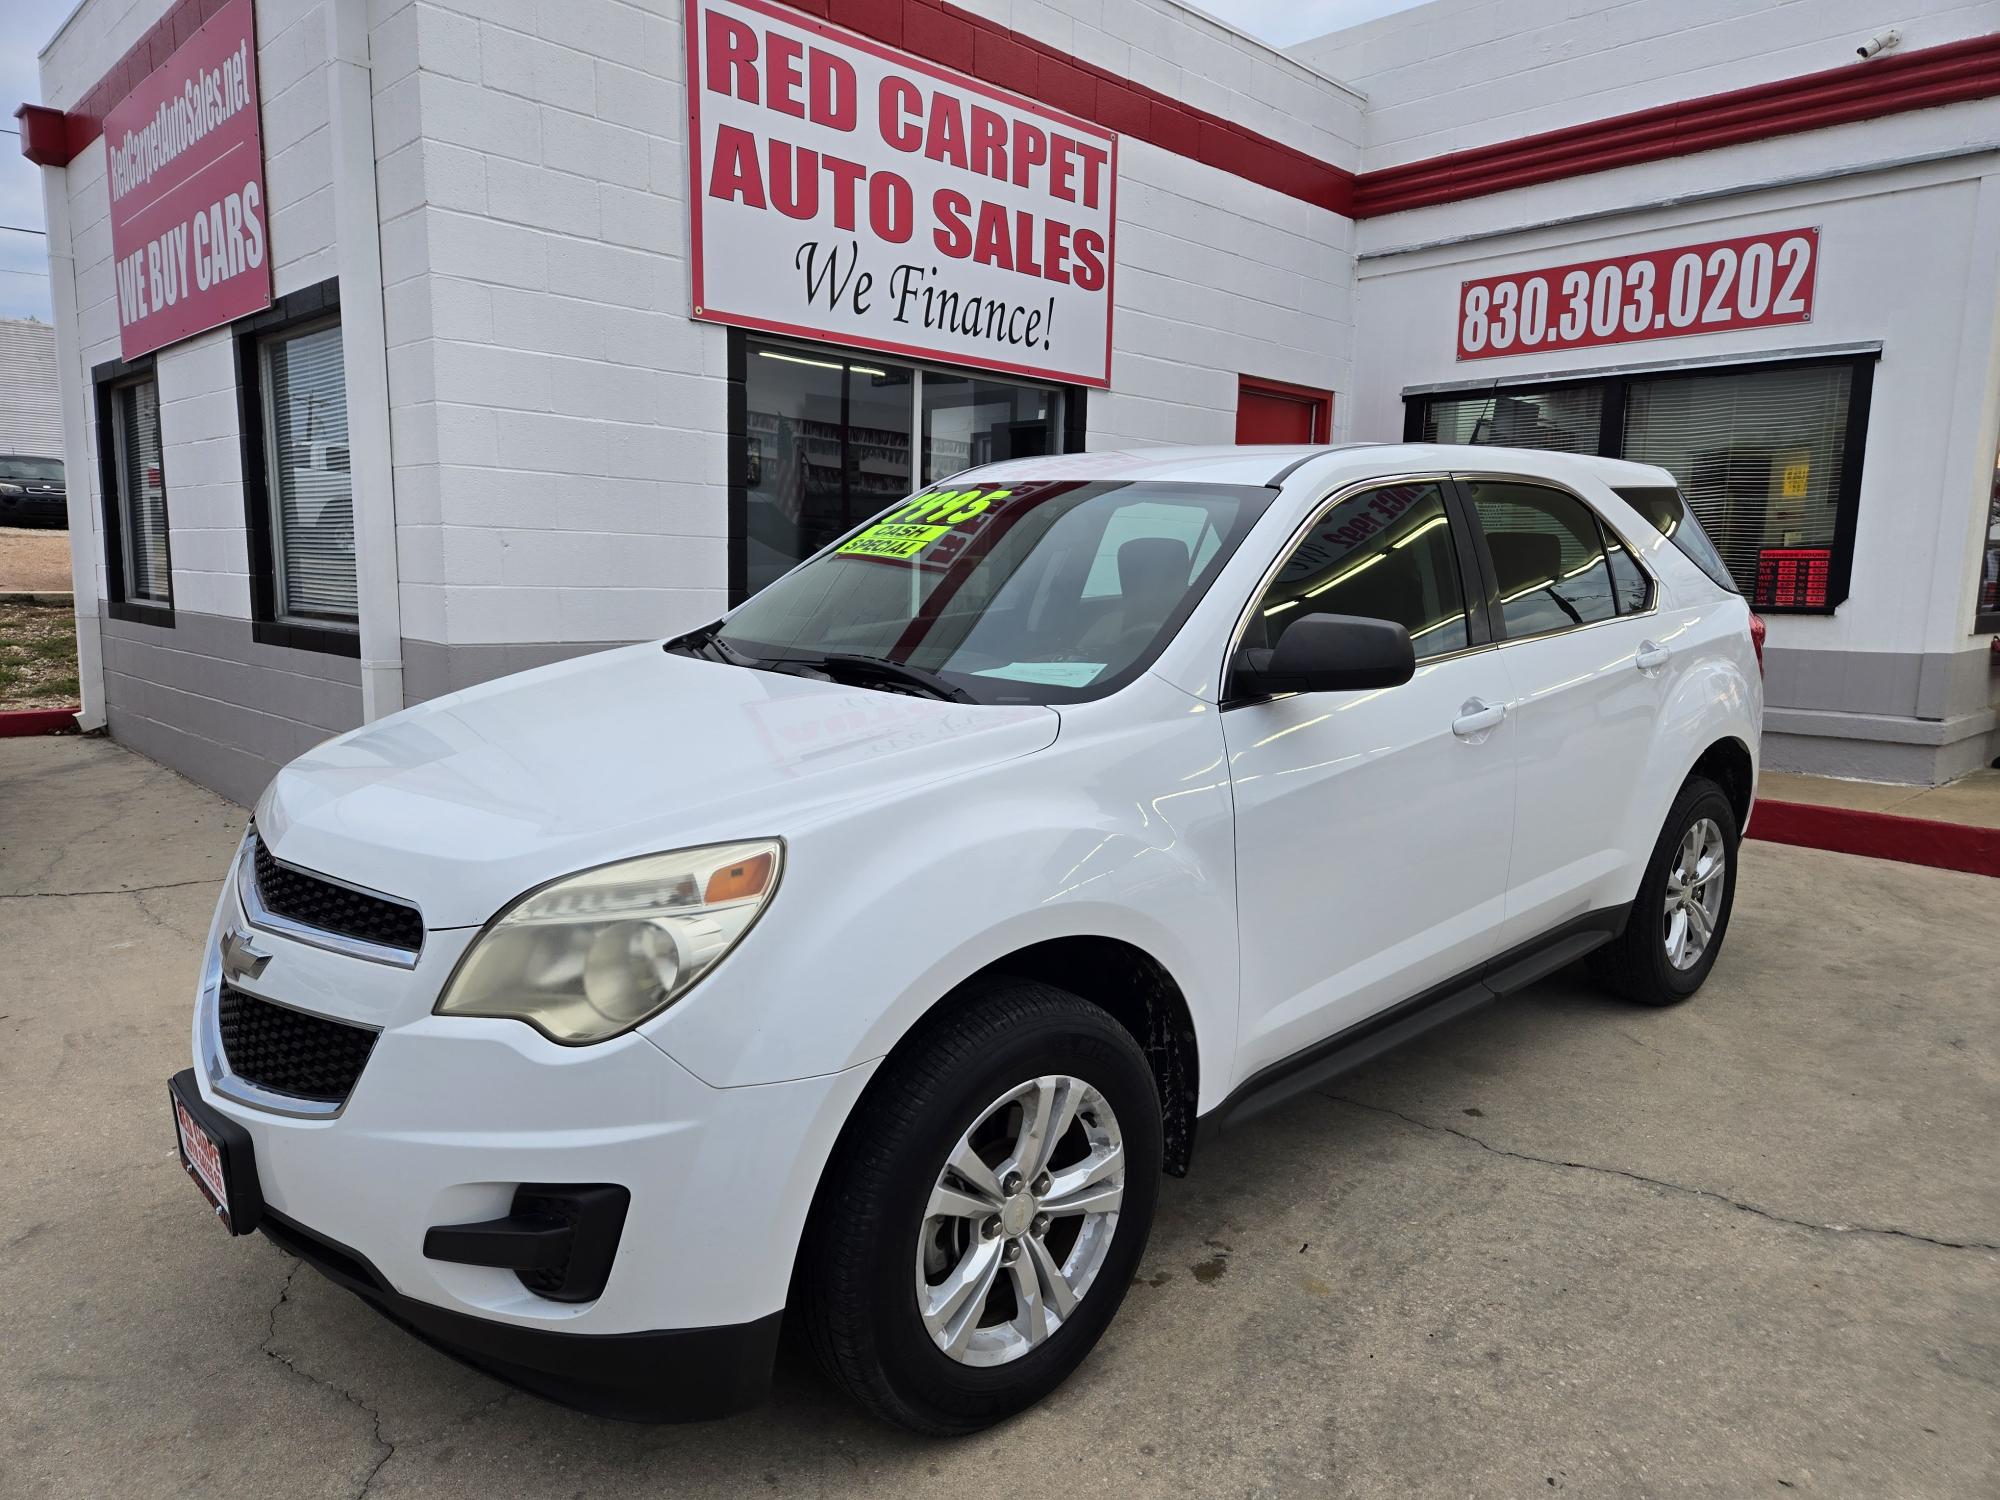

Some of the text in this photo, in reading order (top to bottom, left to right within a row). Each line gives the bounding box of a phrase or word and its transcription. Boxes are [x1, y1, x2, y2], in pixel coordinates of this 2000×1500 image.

[110, 37, 251, 203] RedCarpetAutoSales.net
[705, 9, 1108, 210] RED CARPET
[116, 180, 264, 327] WE BUY CARS
[709, 123, 1105, 292] AUTO SALES
[795, 240, 1055, 352] We Finance!
[1462, 237, 1812, 352] 830.303.0202
[845, 538, 918, 556] SPECIAL
[875, 524, 932, 539] CASH
